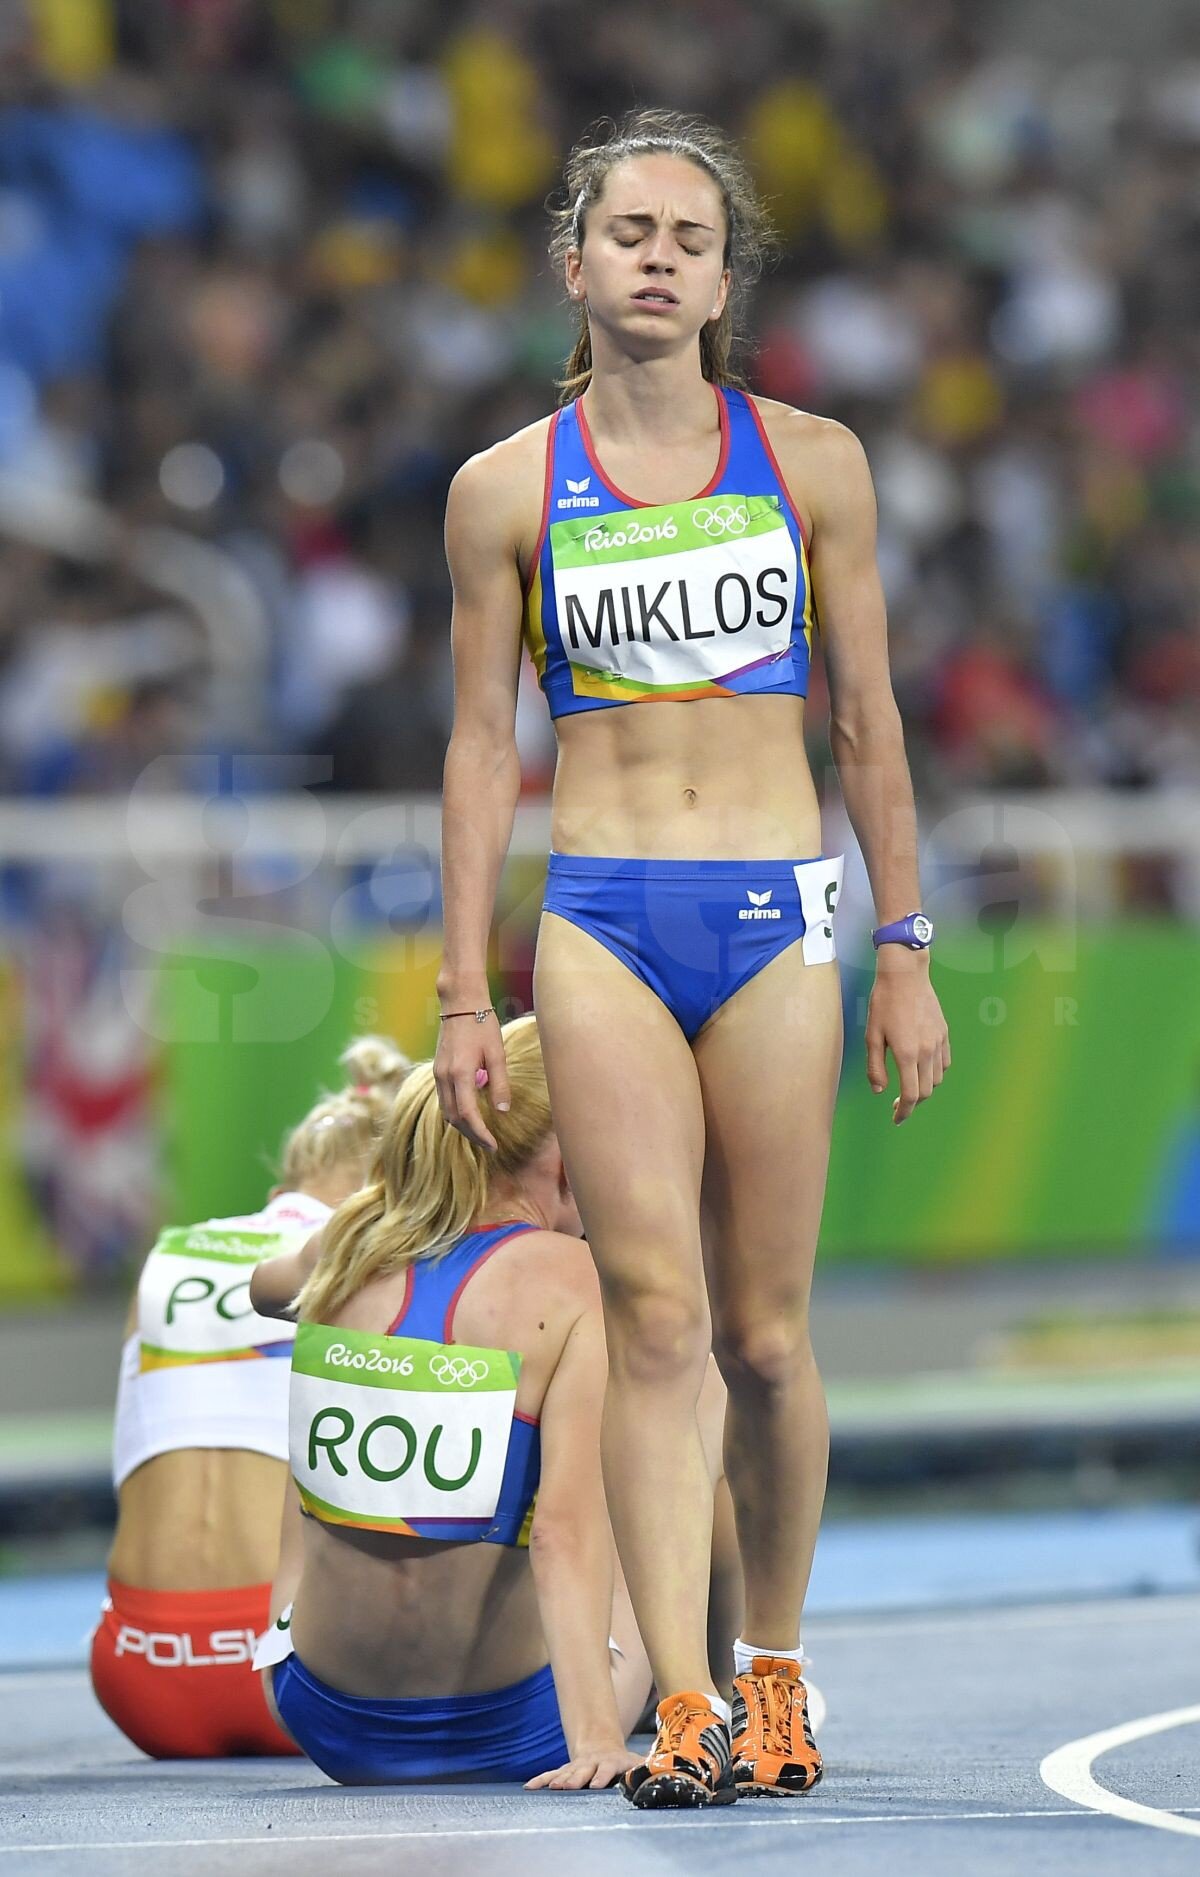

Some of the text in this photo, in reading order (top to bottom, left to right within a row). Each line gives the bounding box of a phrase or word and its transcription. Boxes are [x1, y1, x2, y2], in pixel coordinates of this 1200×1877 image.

[557, 496, 599, 509] erima
[584, 516, 678, 552] Rio2016
[564, 567, 788, 649] MIKLOS
[739, 908, 781, 920] erima
[166, 1277, 254, 1325] PO
[325, 1343, 414, 1376] Rio2016
[308, 1407, 482, 1491] ROU
